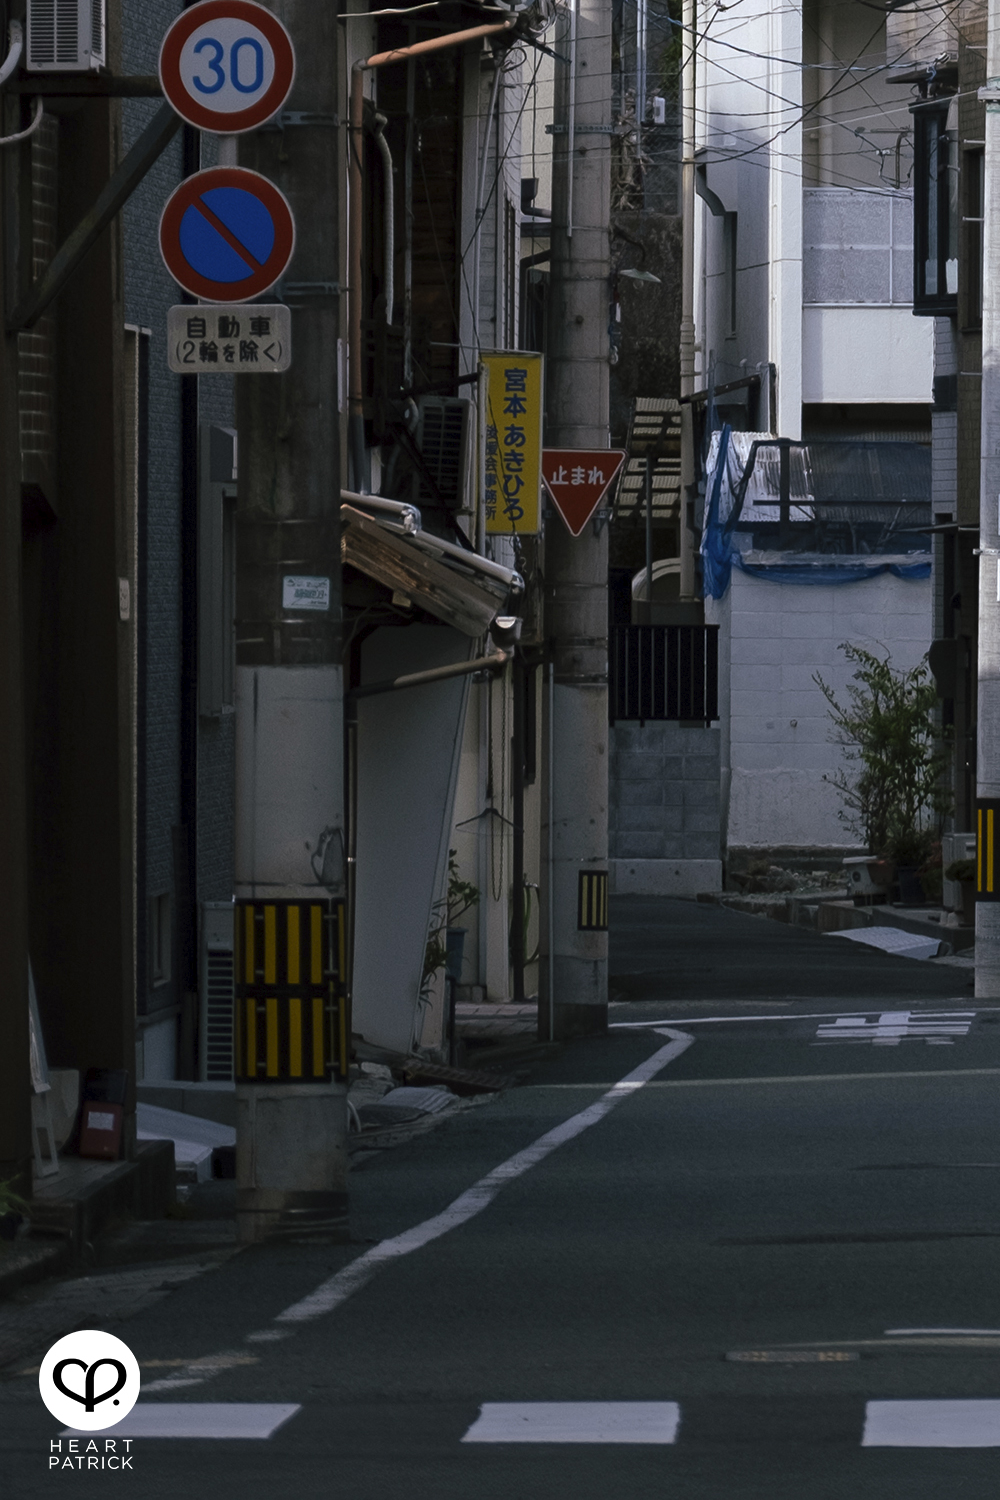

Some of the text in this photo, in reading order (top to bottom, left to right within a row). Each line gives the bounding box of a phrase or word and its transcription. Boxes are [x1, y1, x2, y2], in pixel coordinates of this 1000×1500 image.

[192, 36, 264, 94] 30
[187, 315, 271, 339] 自動車
[176, 340, 283, 364] (2輪を除く)
[550, 465, 606, 486] 止まれ
